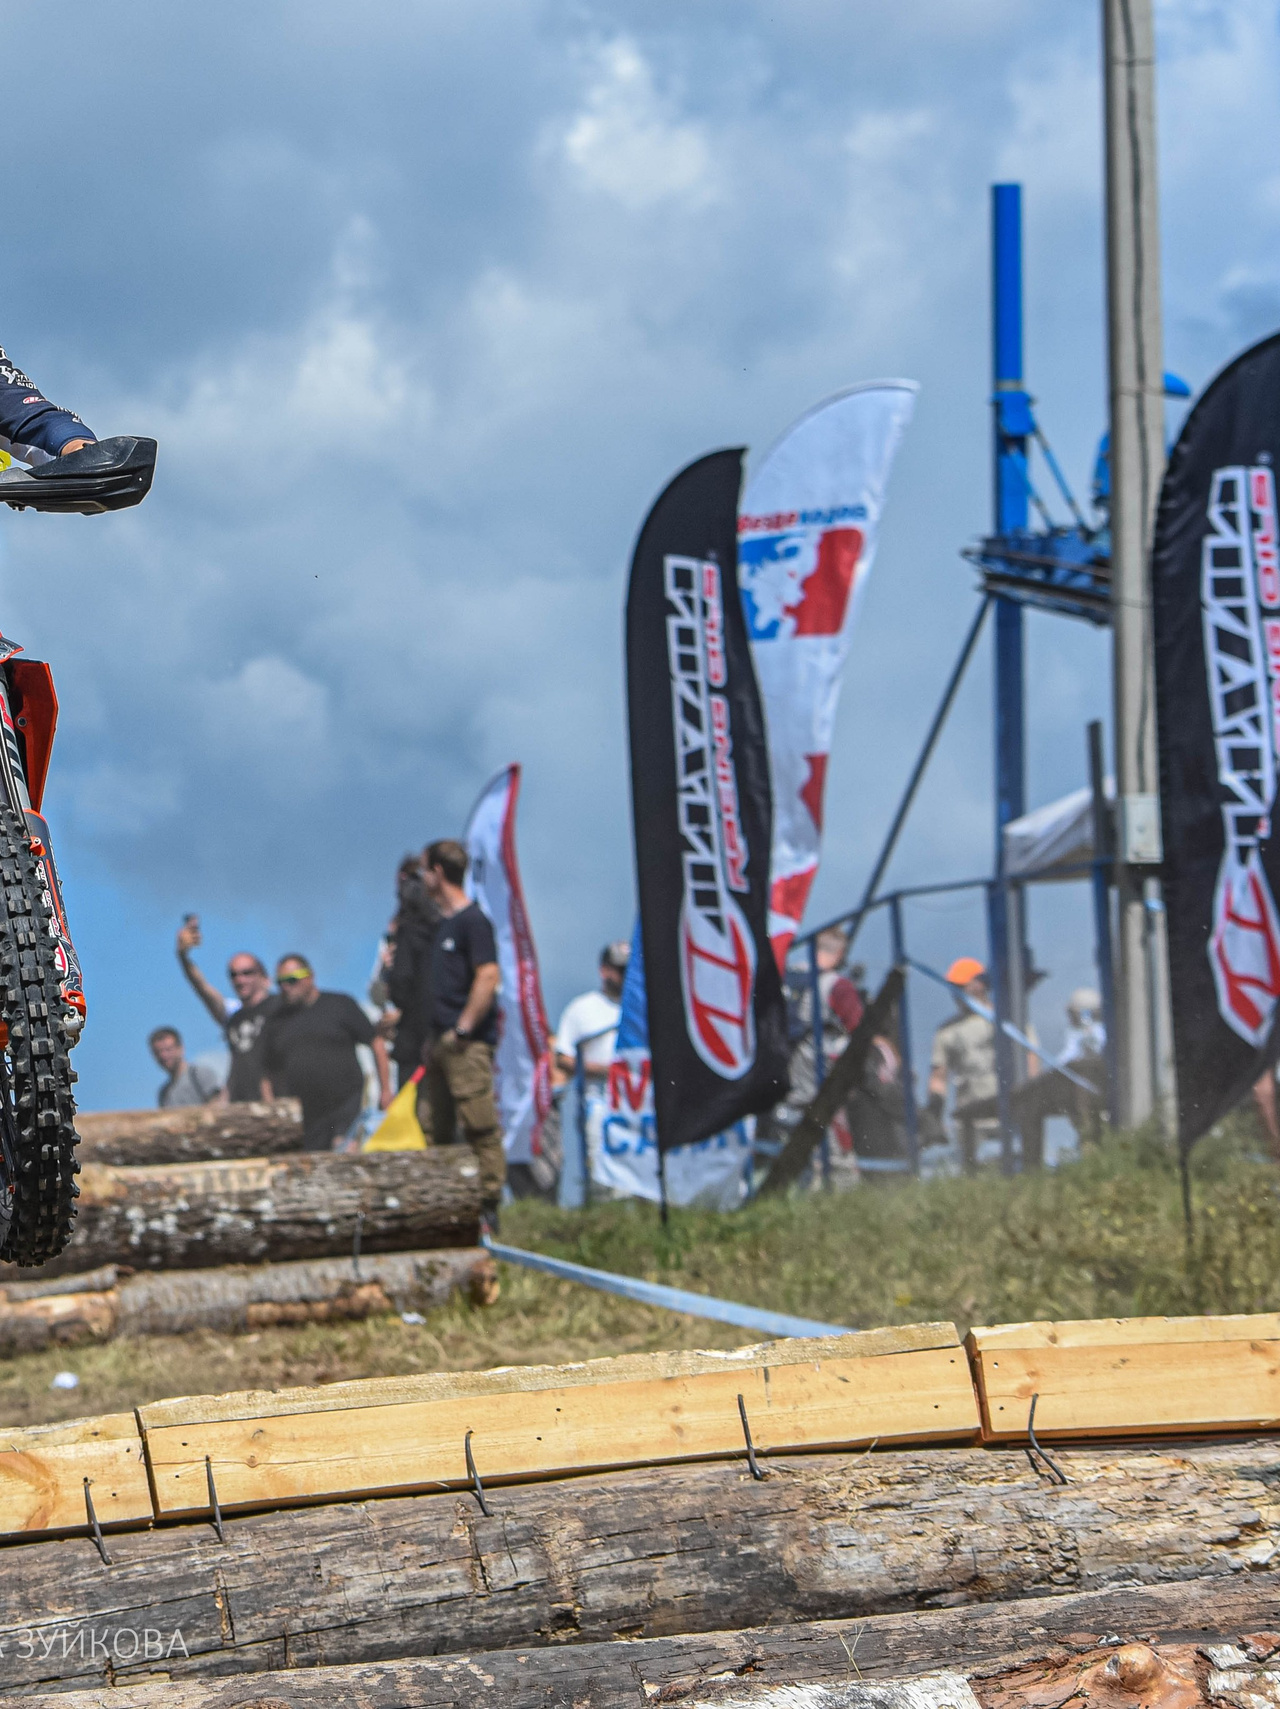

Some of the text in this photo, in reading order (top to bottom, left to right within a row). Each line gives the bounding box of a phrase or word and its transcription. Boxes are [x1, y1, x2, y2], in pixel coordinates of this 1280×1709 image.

[662, 553, 726, 936] MAXIMA
[701, 561, 751, 893] RACING OILS
